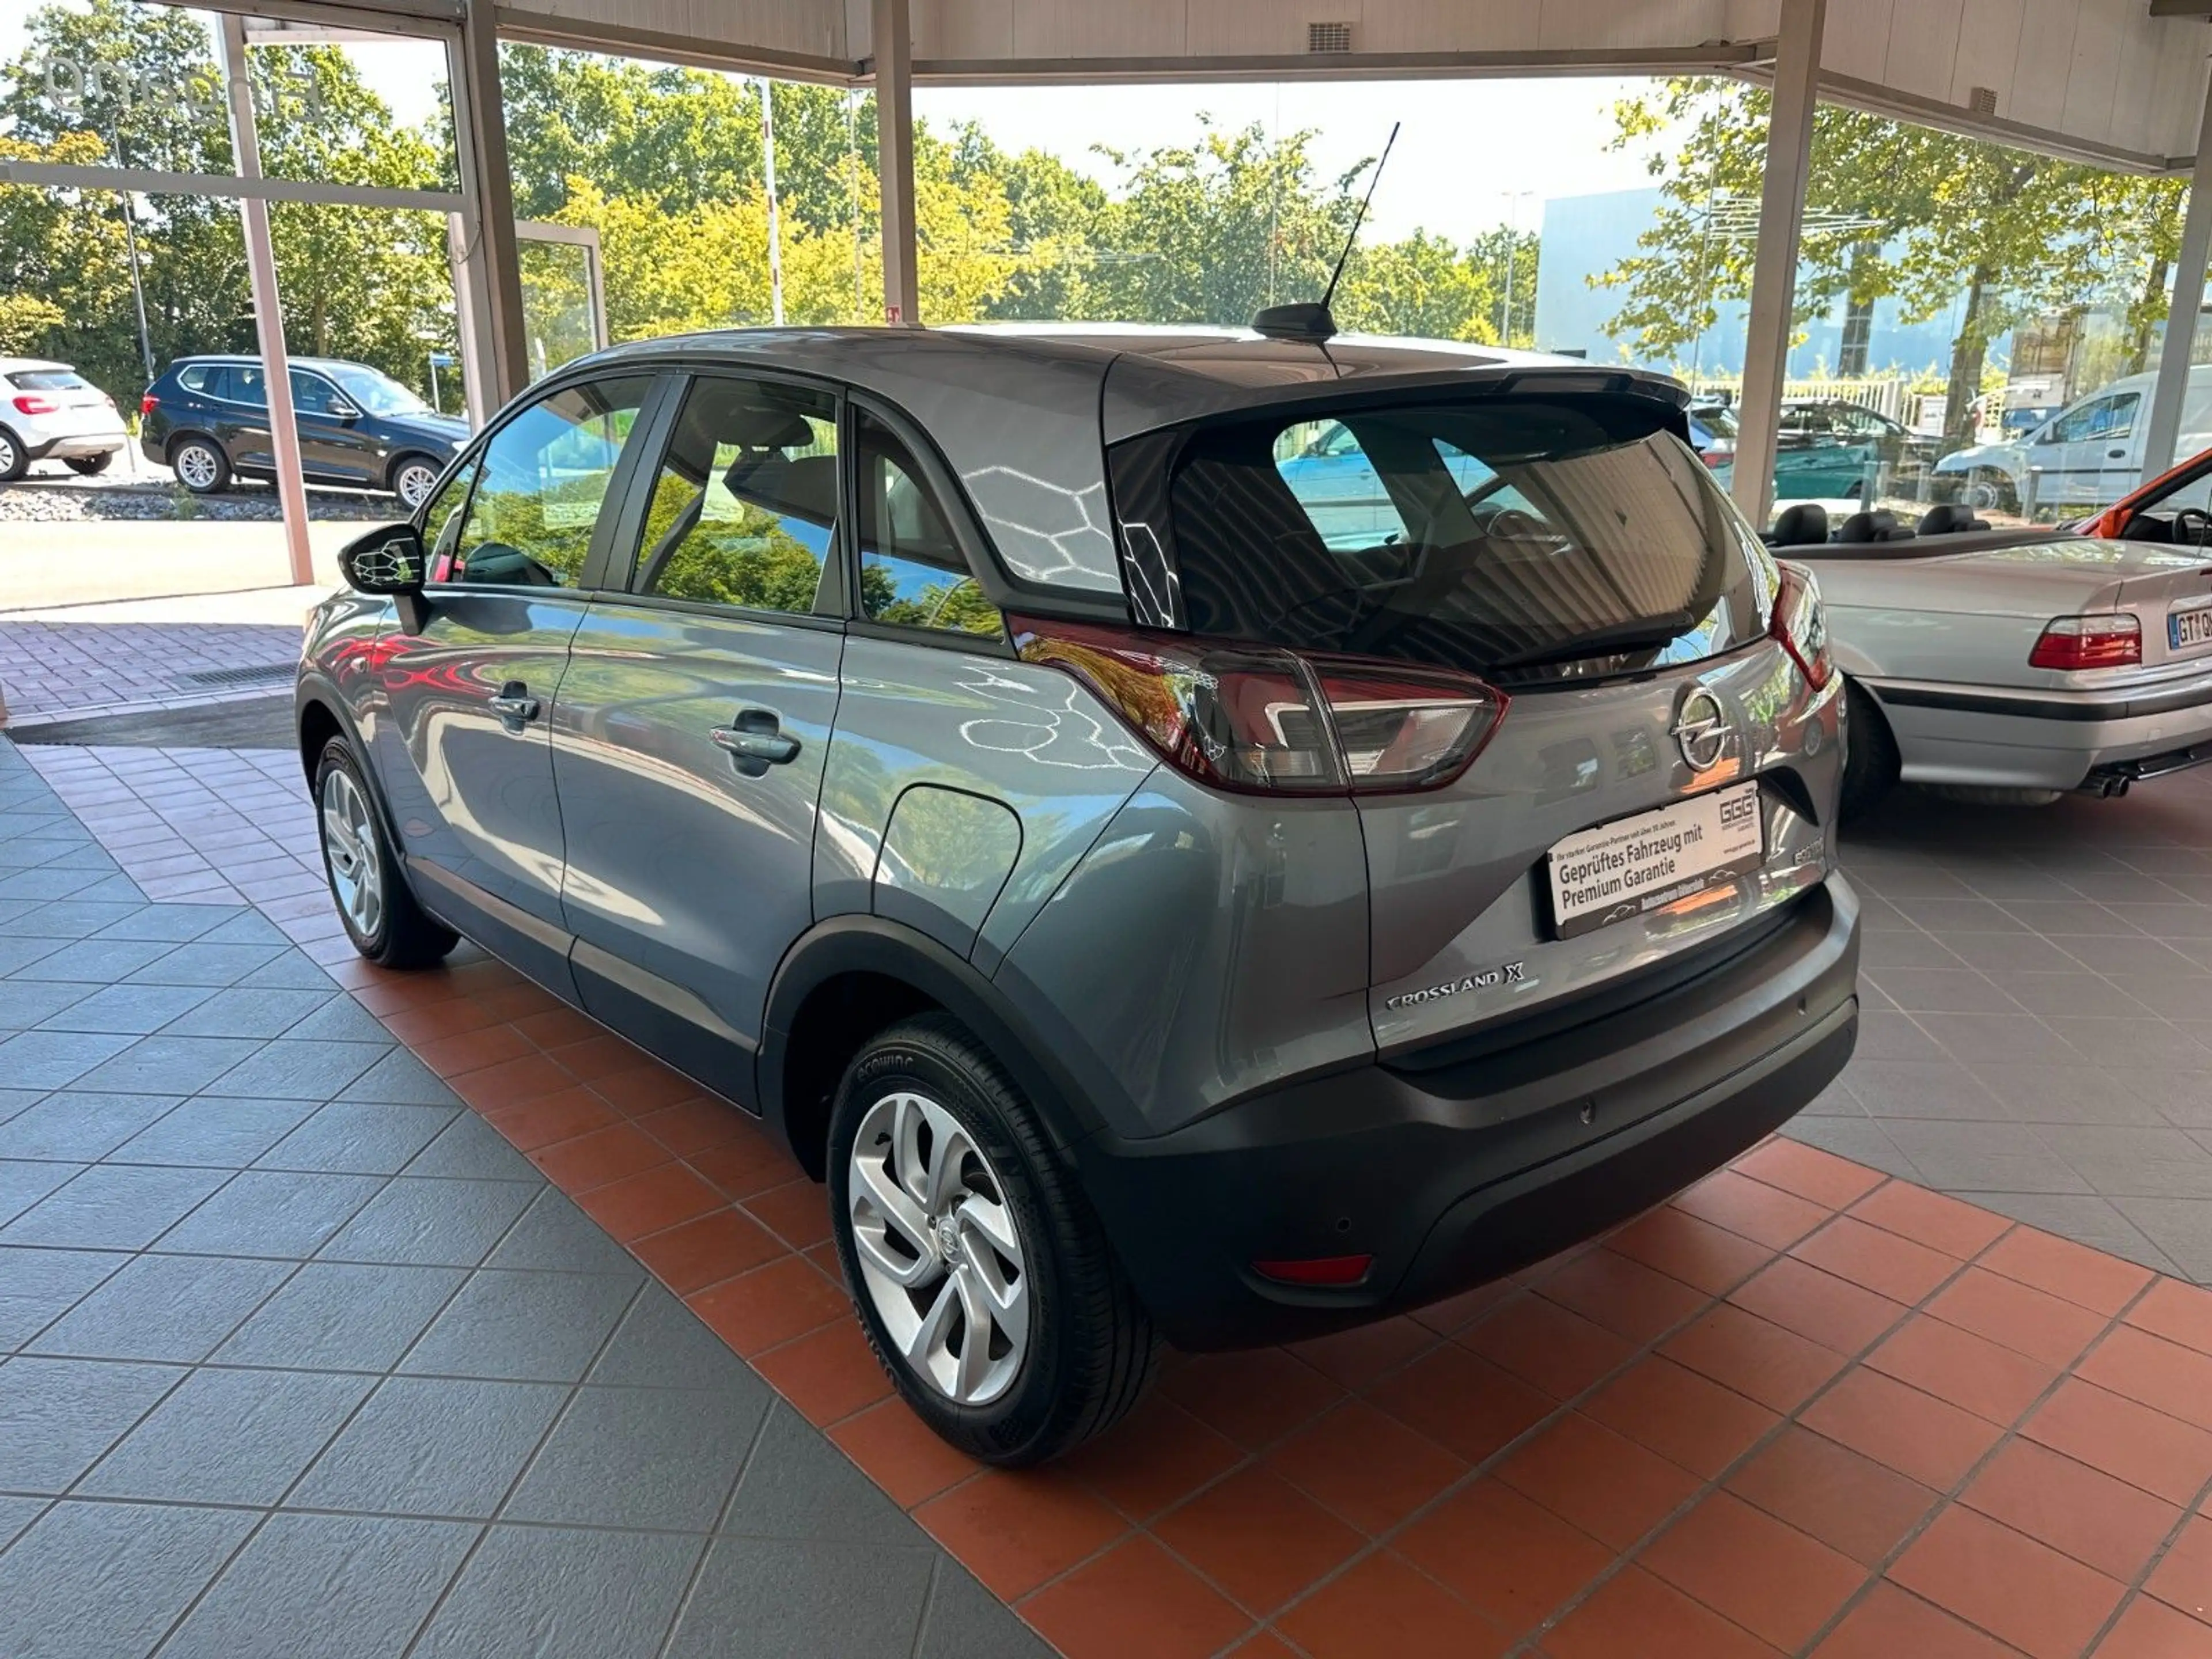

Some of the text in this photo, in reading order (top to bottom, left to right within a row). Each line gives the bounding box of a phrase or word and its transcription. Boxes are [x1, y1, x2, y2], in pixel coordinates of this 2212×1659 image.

[2178, 615, 2194, 643] GT
[1719, 794, 1753, 824] GGG
[1559, 851, 1624, 885] Geprüftes
[1626, 833, 1682, 863] Fahrzeug
[1683, 823, 1703, 846] mit
[1562, 877, 1622, 910] Premium
[1623, 856, 1676, 888] Garantie
[1385, 961, 1525, 1010] CROSSLAND X
